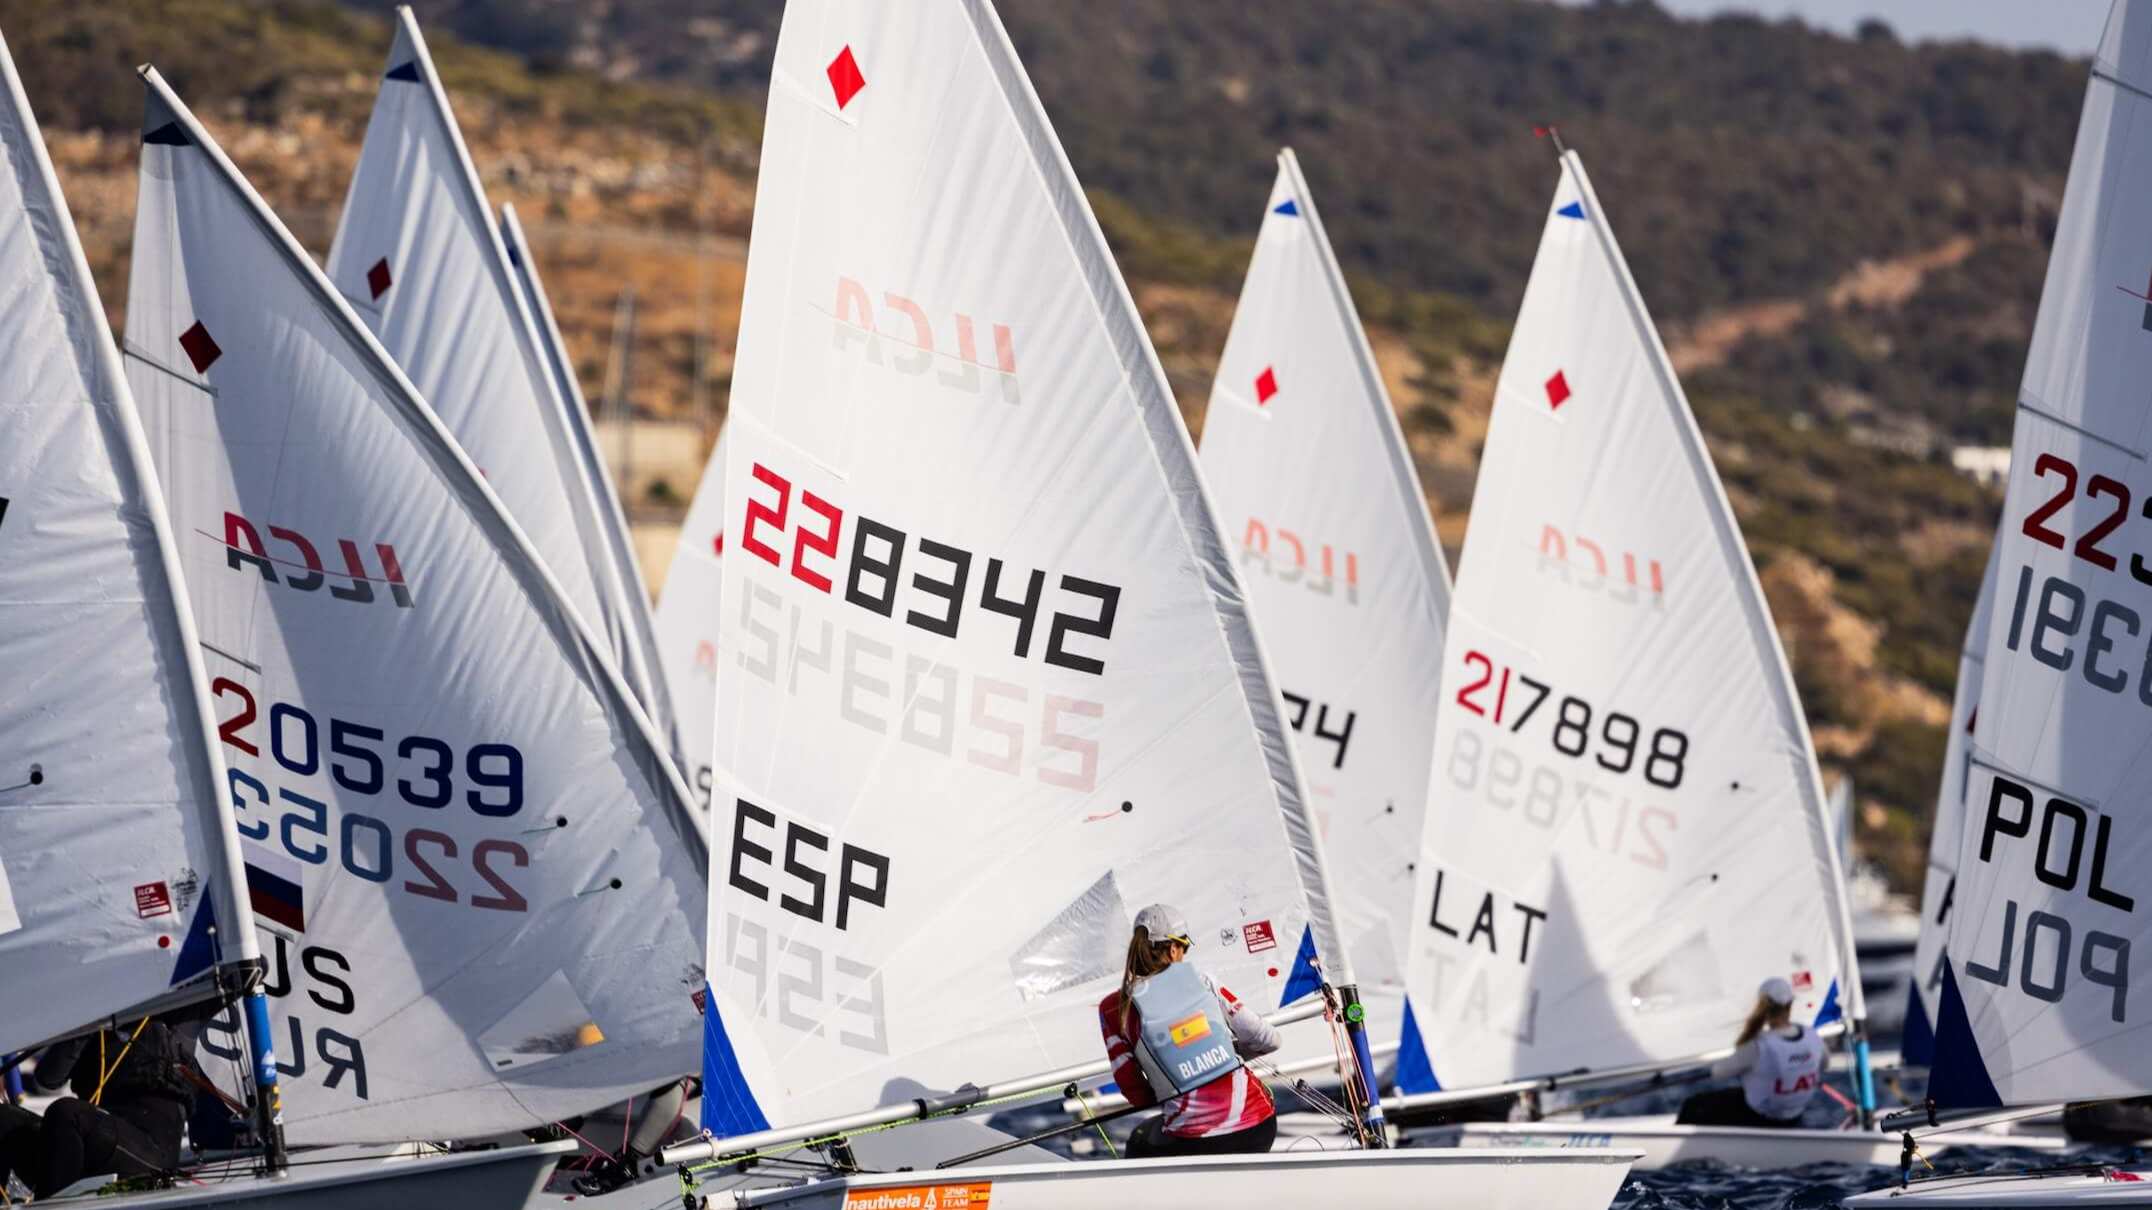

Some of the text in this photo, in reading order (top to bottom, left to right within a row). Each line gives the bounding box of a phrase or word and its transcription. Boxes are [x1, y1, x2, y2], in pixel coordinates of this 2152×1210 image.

[742, 462, 1121, 675] 228342
[1456, 650, 1689, 789] 217898
[729, 798, 889, 930] ESP
[1979, 776, 2135, 912] POL
[1430, 870, 1547, 964] LAT
[1178, 1045, 1230, 1078] BLANCA
[848, 1193, 920, 1210] nautivela
[943, 1199, 968, 1207] TEAM
